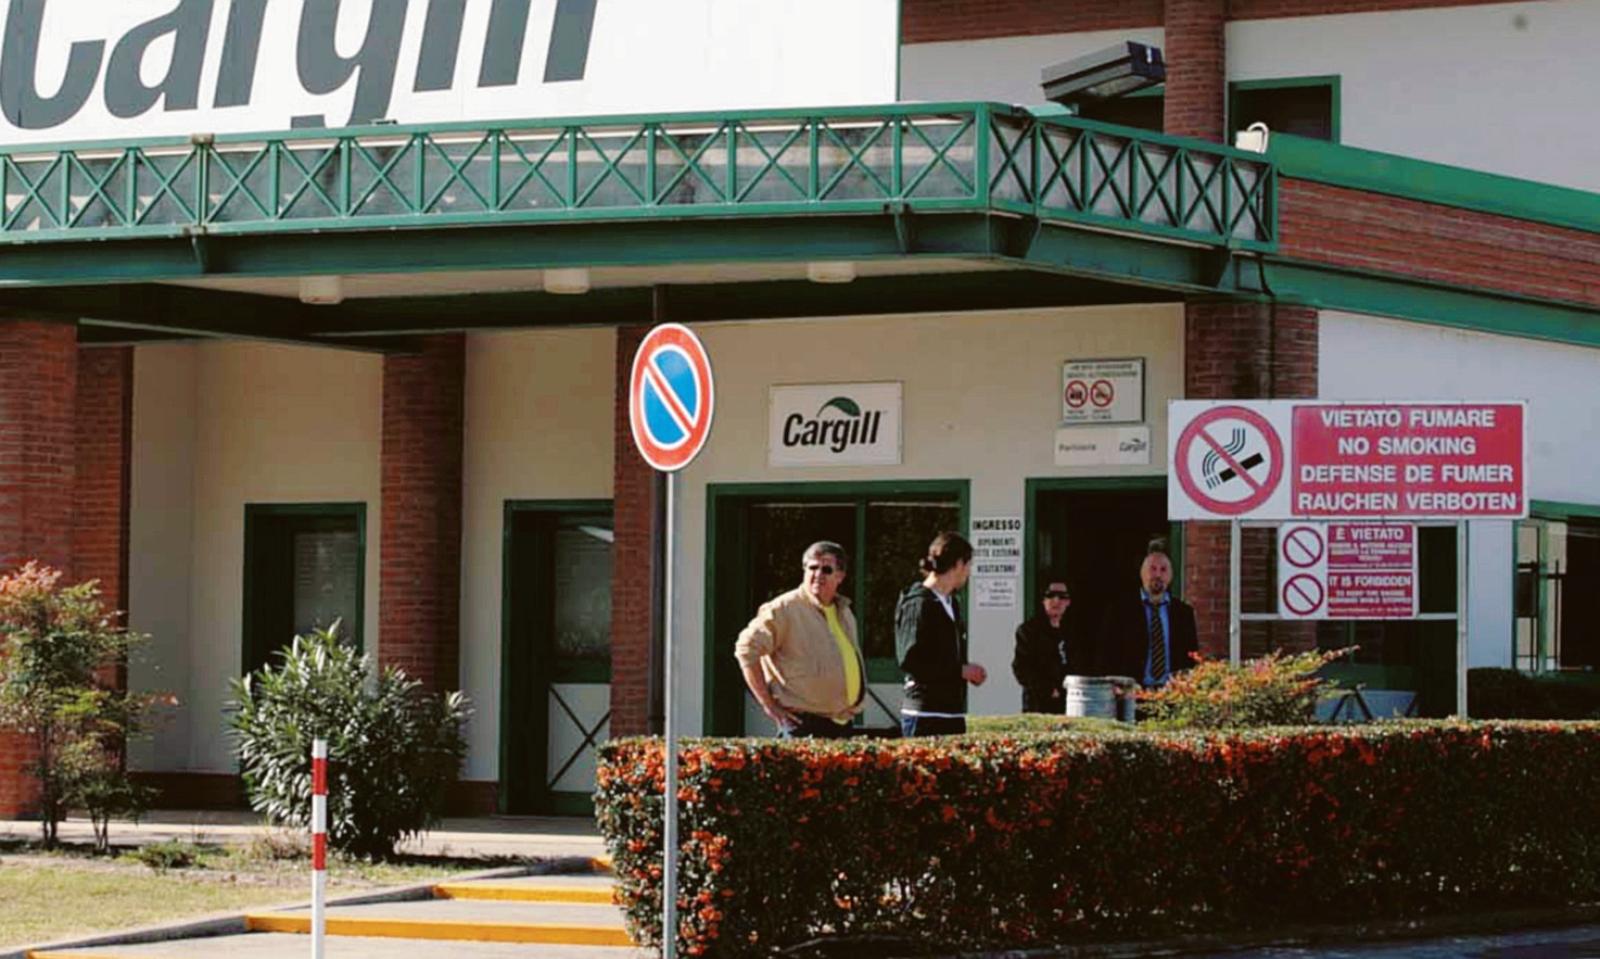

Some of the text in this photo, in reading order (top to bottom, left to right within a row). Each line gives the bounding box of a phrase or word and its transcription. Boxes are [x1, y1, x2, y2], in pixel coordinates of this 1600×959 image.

[1321, 409, 1495, 427] VIETATO FUMARE
[783, 411, 881, 453] Cargill
[1339, 437, 1475, 455] NO SMOKING
[1301, 465, 1513, 482] DEFENSE DE FUMER
[1299, 493, 1516, 510] RAUCHEN VERBOTEN
[972, 519, 1021, 531] INGRESSO
[1351, 528, 1404, 540] VIETATO
[1329, 576, 1338, 587] IT
[1355, 576, 1411, 587] FORBIDDEN
